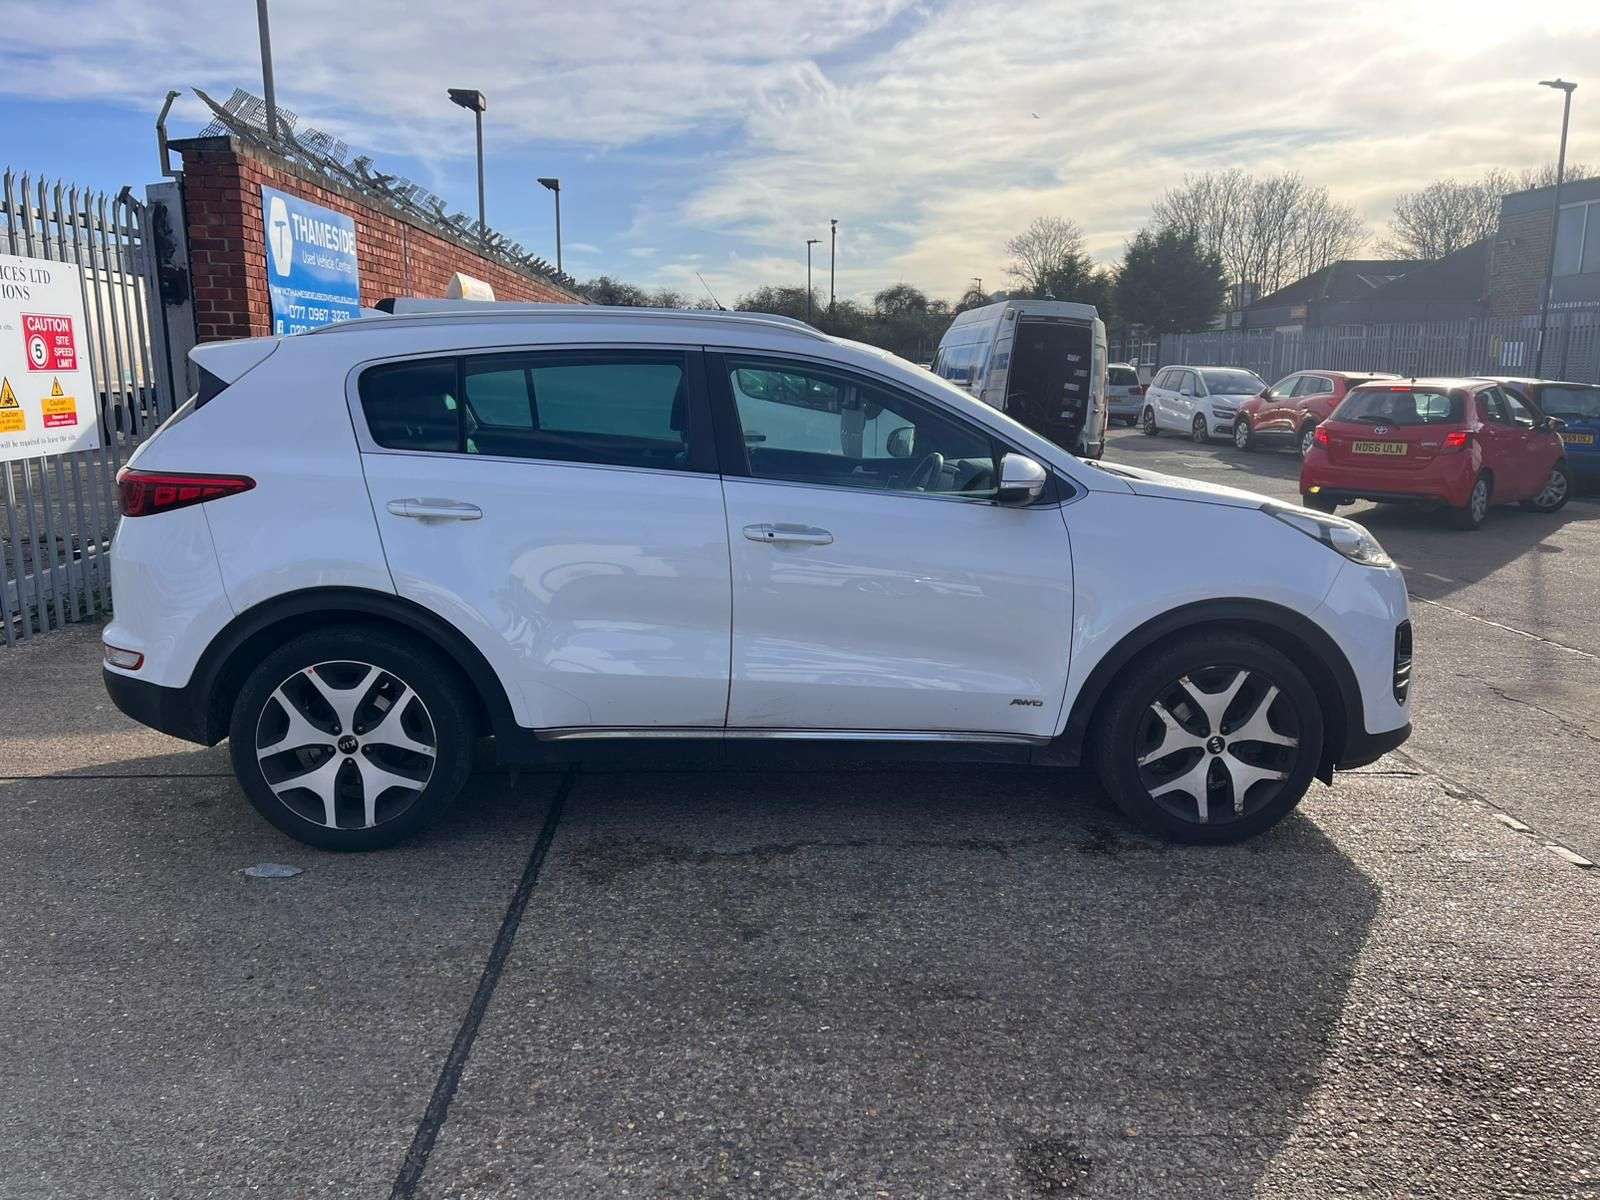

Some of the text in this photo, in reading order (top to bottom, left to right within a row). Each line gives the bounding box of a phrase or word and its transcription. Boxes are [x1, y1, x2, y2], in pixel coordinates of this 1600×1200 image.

[292, 212, 356, 256] THAMESIDE
[303, 251, 316, 265] Used
[316, 252, 335, 270] Vehicle
[30, 268, 51, 284] LTD
[289, 305, 305, 319] 077
[27, 317, 69, 332] CAUTION
[55, 336, 71, 345] SITE
[35, 344, 43, 359] 5
[54, 347, 73, 357] SPEED
[57, 359, 73, 368] LIMIT
[1354, 442, 1380, 452] ND66
